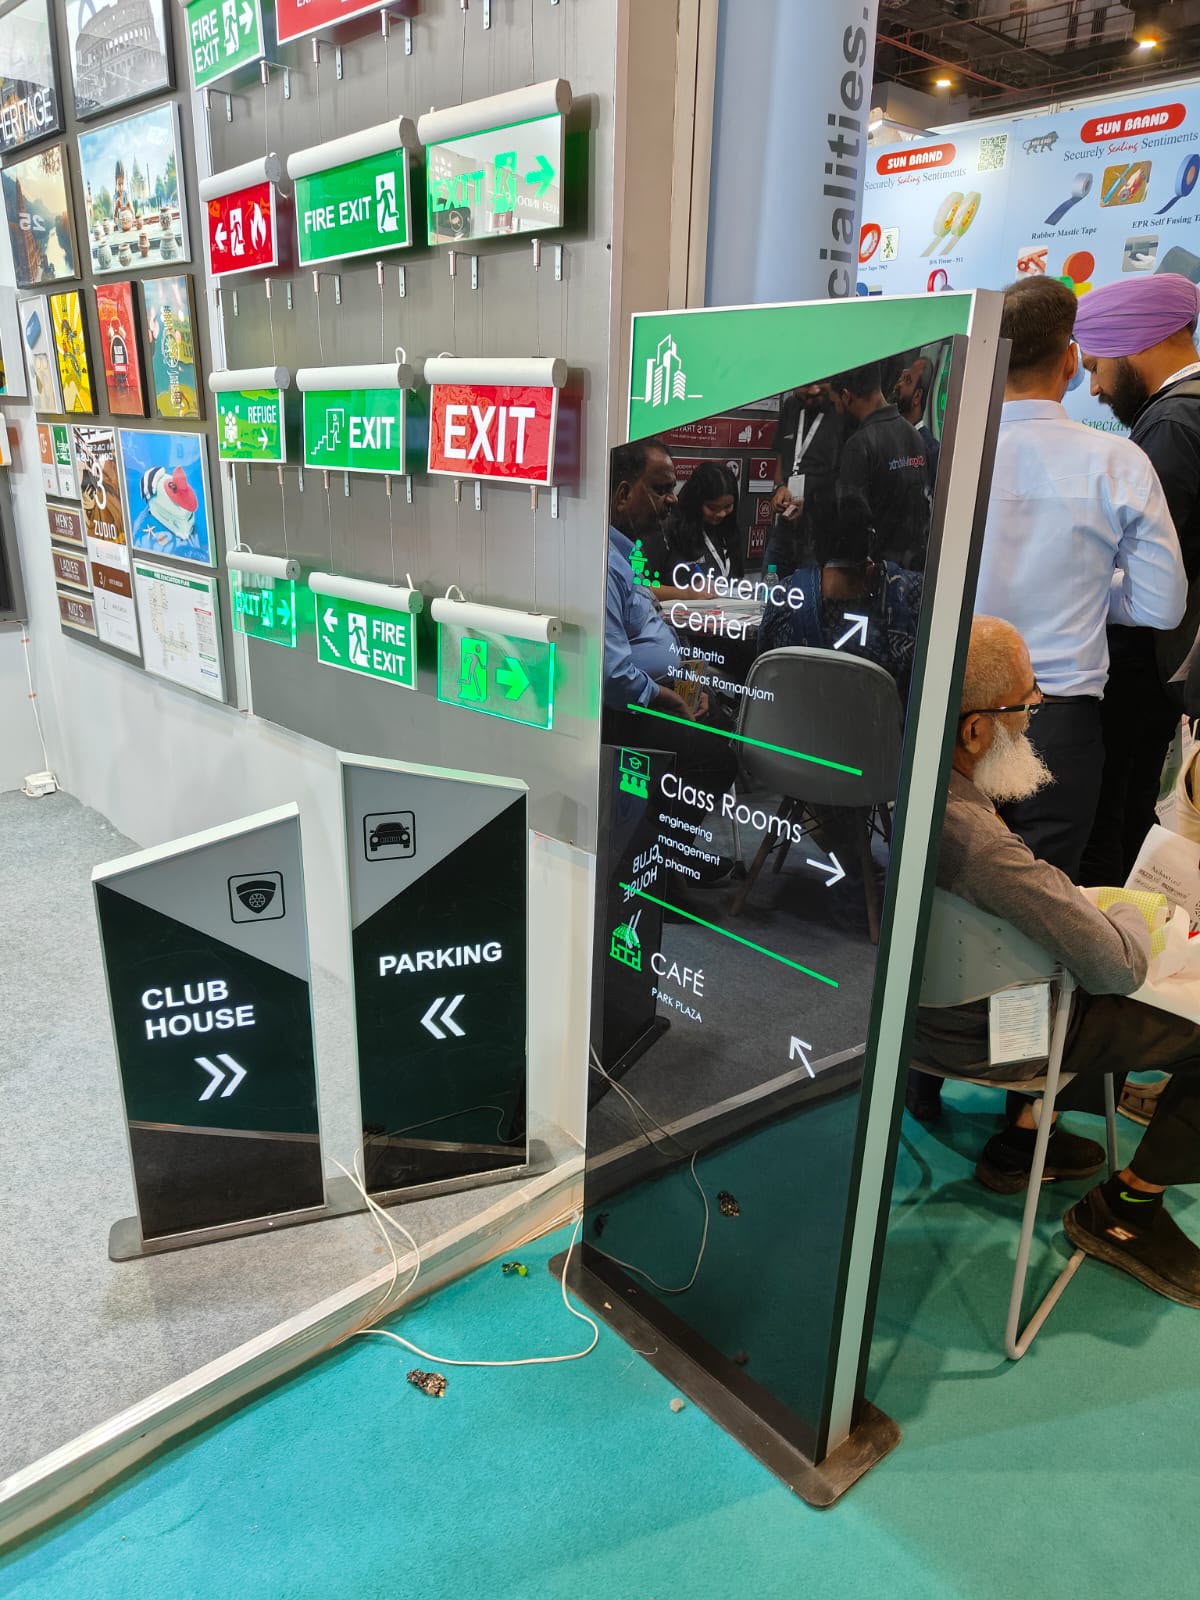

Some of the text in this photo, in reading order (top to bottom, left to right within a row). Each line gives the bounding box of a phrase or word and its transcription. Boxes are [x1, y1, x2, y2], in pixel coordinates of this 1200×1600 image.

[191, 8, 219, 46] FIRE
[194, 38, 220, 73] EXIT
[1095, 111, 1169, 137] SUN BRAND
[819, 6, 870, 300] cialities.
[887, 150, 943, 170] SUN BRAND
[1063, 145, 1105, 162] Securely
[1141, 131, 1199, 149] Sentiments
[431, 169, 486, 213] EXIT
[864, 177, 895, 191] Securely
[922, 167, 967, 182] Sentiments
[304, 195, 372, 234] FIRE EXIT
[1131, 218, 1149, 229] EPR
[1150, 217, 1165, 227] Self
[1166, 215, 1192, 227] Fusing
[1031, 226, 1097, 240] Rubber Mastic Tape
[247, 404, 277, 425] REFUGE
[349, 415, 395, 450] EXIT
[443, 404, 536, 464] EXIT
[55, 512, 74, 531] MEN'S
[93, 519, 117, 540] ZUDIO
[672, 562, 805, 610] Coference
[235, 591, 260, 617] EXIT
[372, 611, 406, 647] FIRE
[670, 602, 750, 641] Center
[373, 648, 406, 678] EXIT
[668, 642, 725, 665] Ayra Bhatta
[667, 665, 775, 703] Shri Nivas Ramanujam
[660, 773, 802, 844] Class Rooms
[659, 812, 713, 843] engineering
[658, 833, 721, 867] management
[665, 858, 701, 880] pharma
[378, 941, 503, 977] PARKING
[651, 952, 706, 998] CAFÉ
[141, 980, 230, 1011] CLUB
[651, 986, 703, 1024] PARK PLAZA
[145, 1005, 256, 1040] HOUSE
